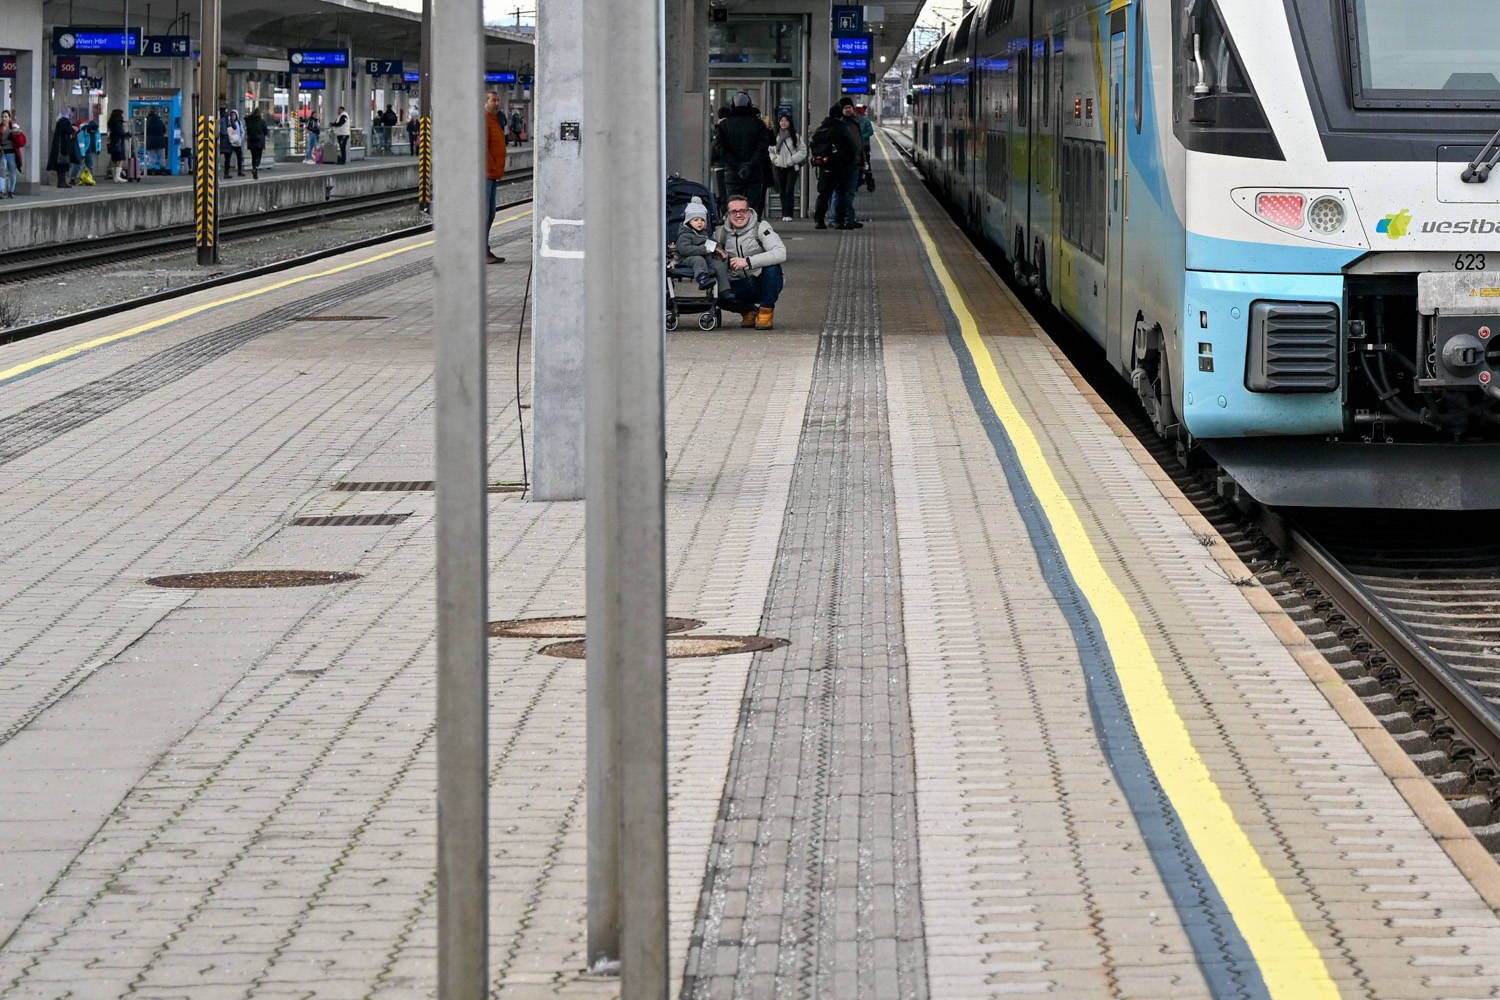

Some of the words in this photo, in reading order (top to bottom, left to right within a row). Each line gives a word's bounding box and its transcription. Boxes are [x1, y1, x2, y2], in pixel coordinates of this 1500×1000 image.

[153, 42, 162, 54] B
[3, 62, 17, 71] SOS
[61, 63, 76, 72] SOS
[370, 62, 378, 73] B
[385, 62, 393, 73] 7
[1454, 253, 1486, 271] 623
